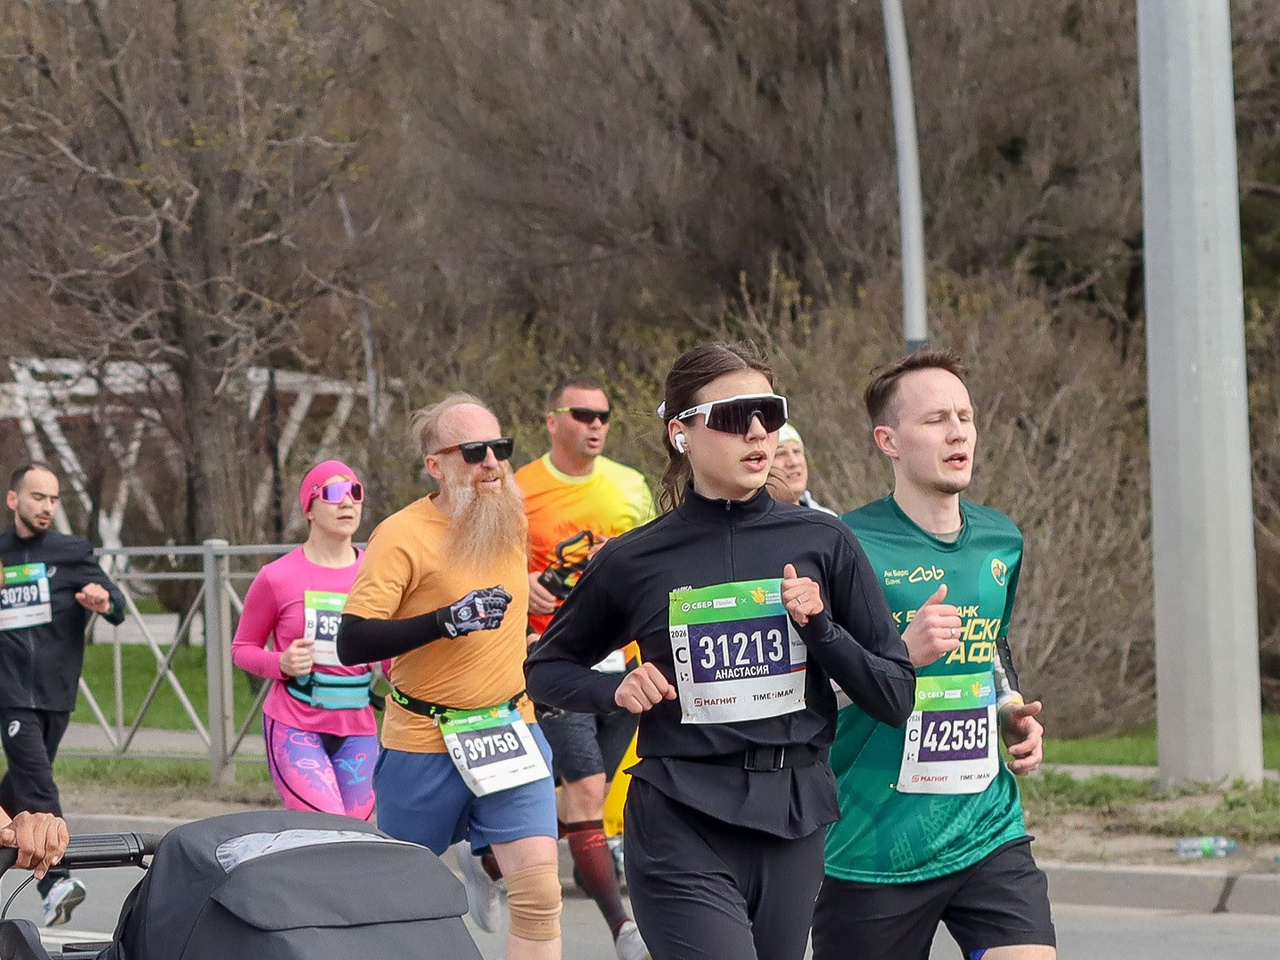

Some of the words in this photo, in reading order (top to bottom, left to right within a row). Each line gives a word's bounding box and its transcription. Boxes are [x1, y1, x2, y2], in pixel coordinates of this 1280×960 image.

[0, 585, 38, 606] 30789
[692, 600, 713, 610] СБЕР
[956, 605, 979, 617] АНК
[319, 616, 342, 635] 35
[671, 629, 687, 639] 2026
[699, 628, 784, 669] 31213
[715, 664, 770, 680] АНАСТАСИЯ
[704, 696, 738, 706] МАГНИТ
[923, 718, 987, 752] 42535
[464, 731, 519, 761] 39758
